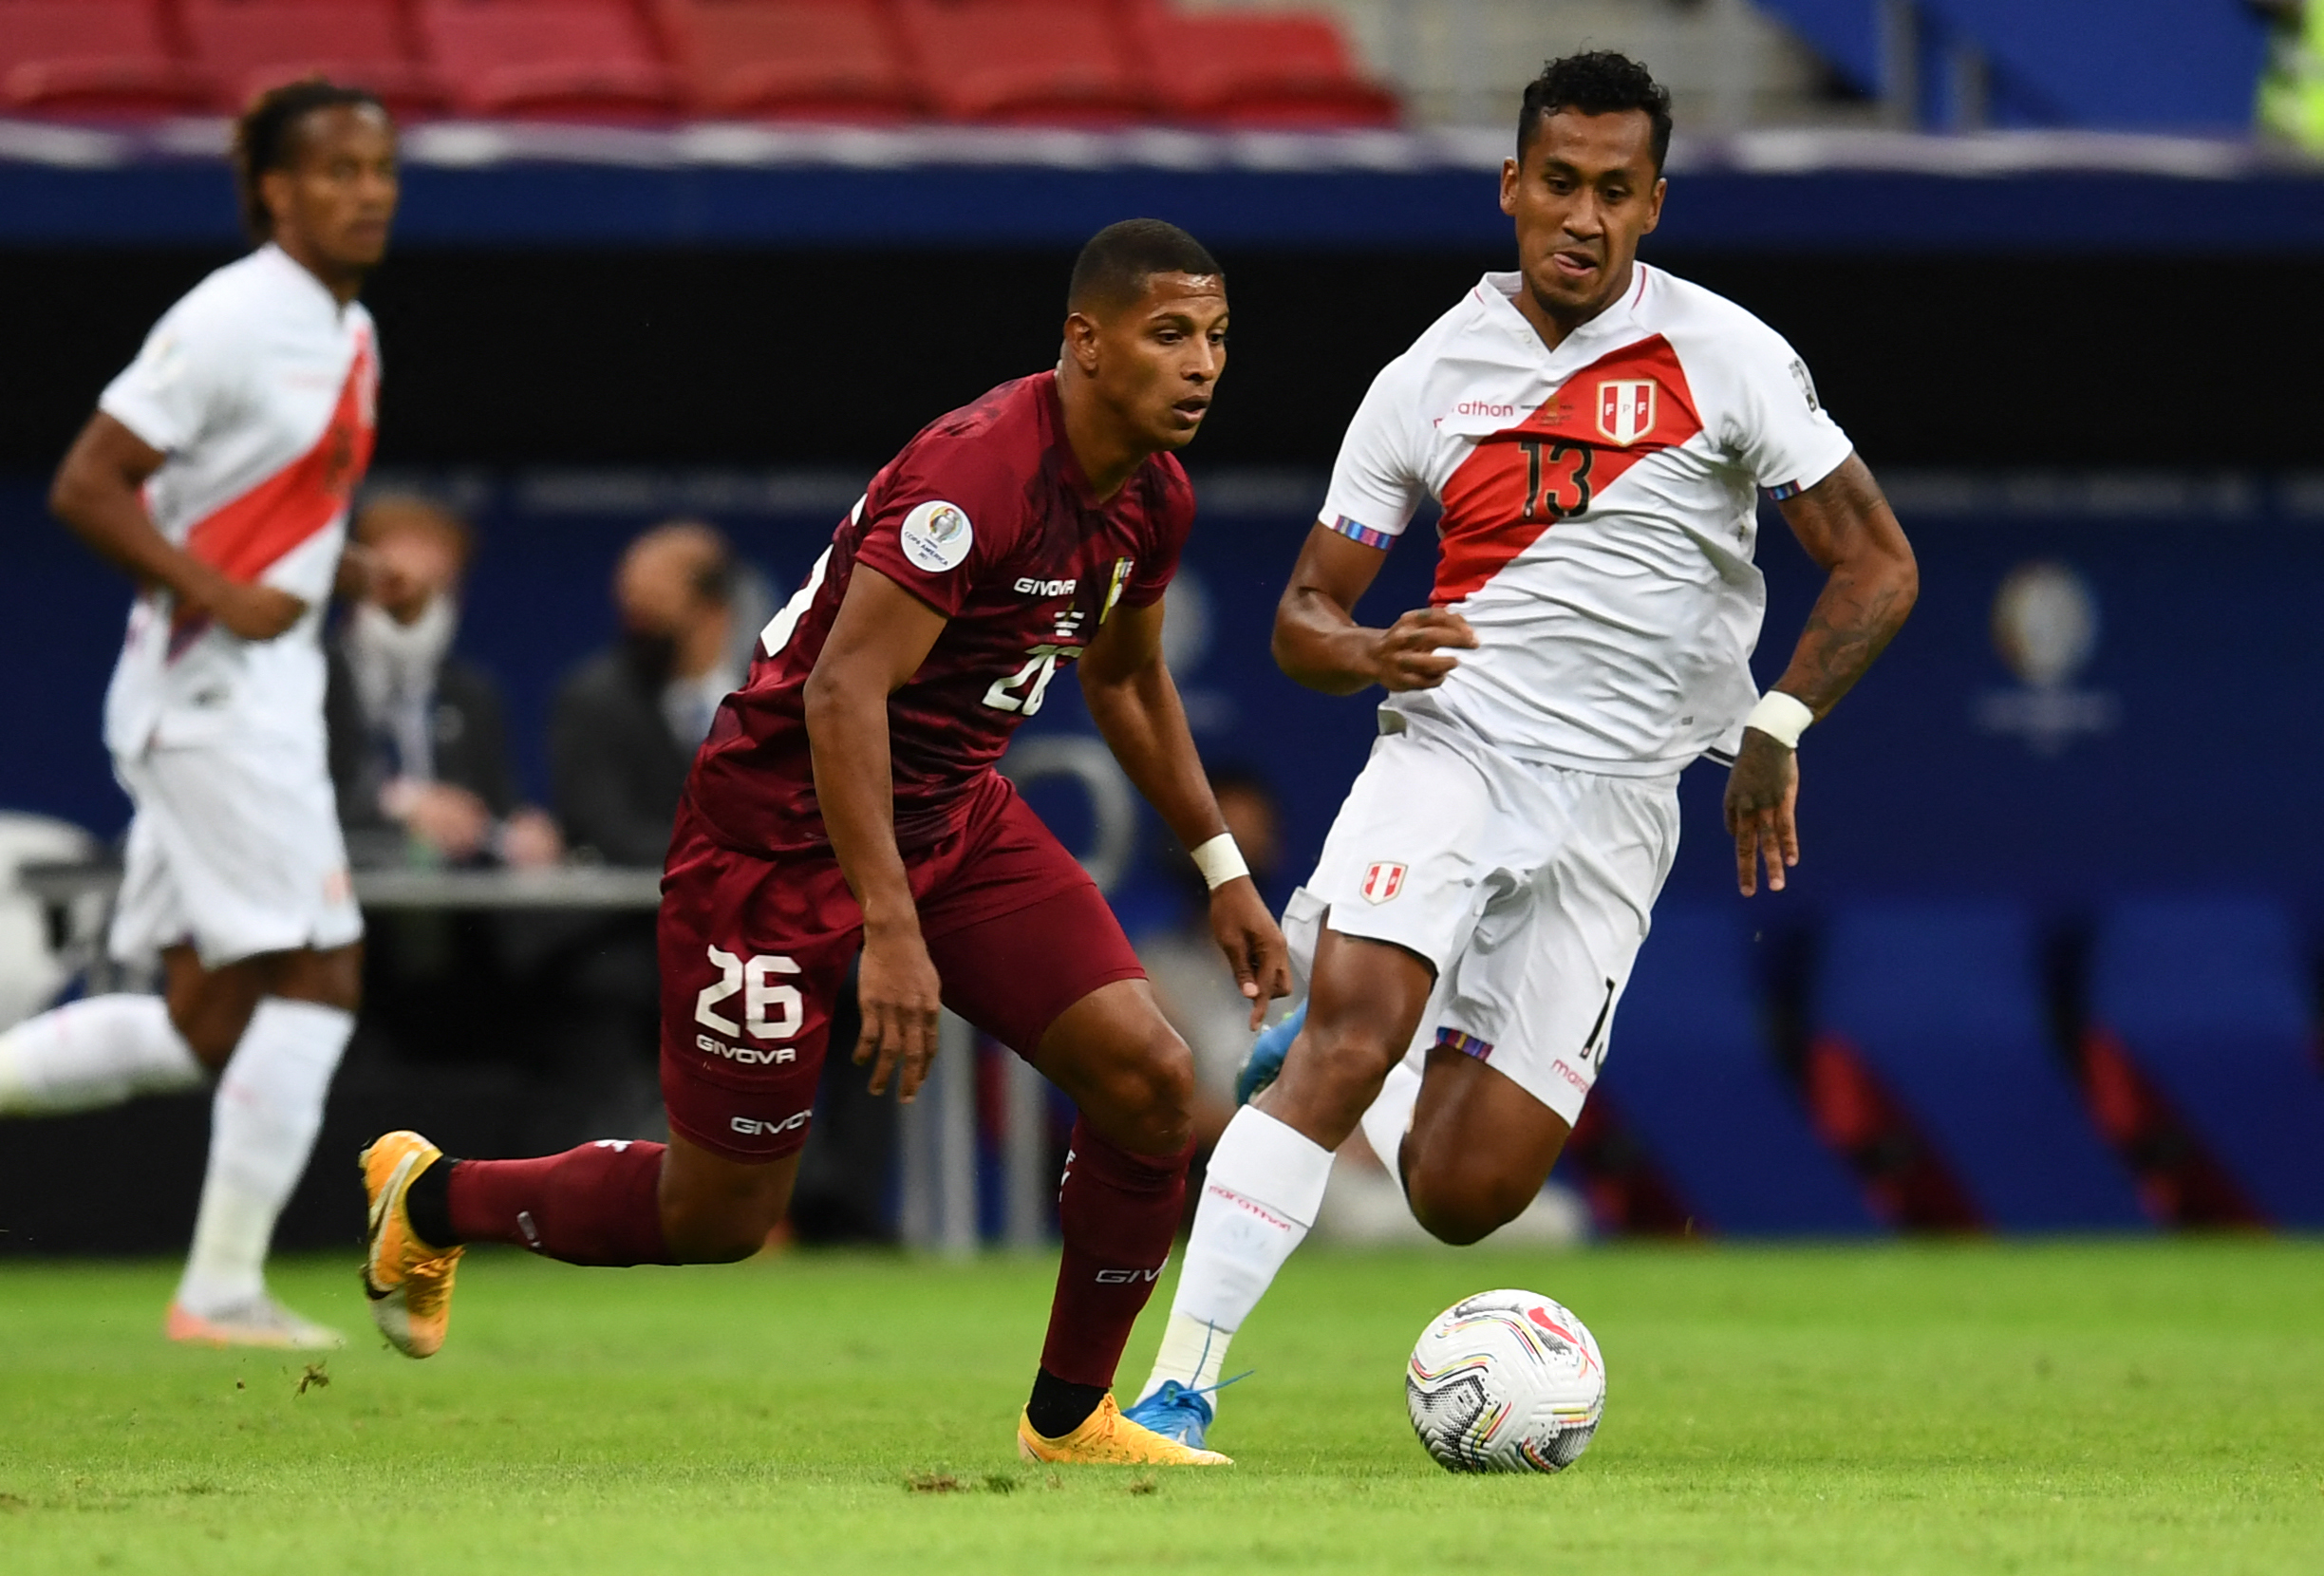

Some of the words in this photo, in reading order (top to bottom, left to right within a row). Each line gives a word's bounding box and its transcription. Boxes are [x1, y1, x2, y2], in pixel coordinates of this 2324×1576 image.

[1519, 440, 1593, 518] 13
[1014, 577, 1077, 596] GIVOVA
[694, 944, 803, 1039] 26
[696, 1034, 797, 1064] GIVOVA
